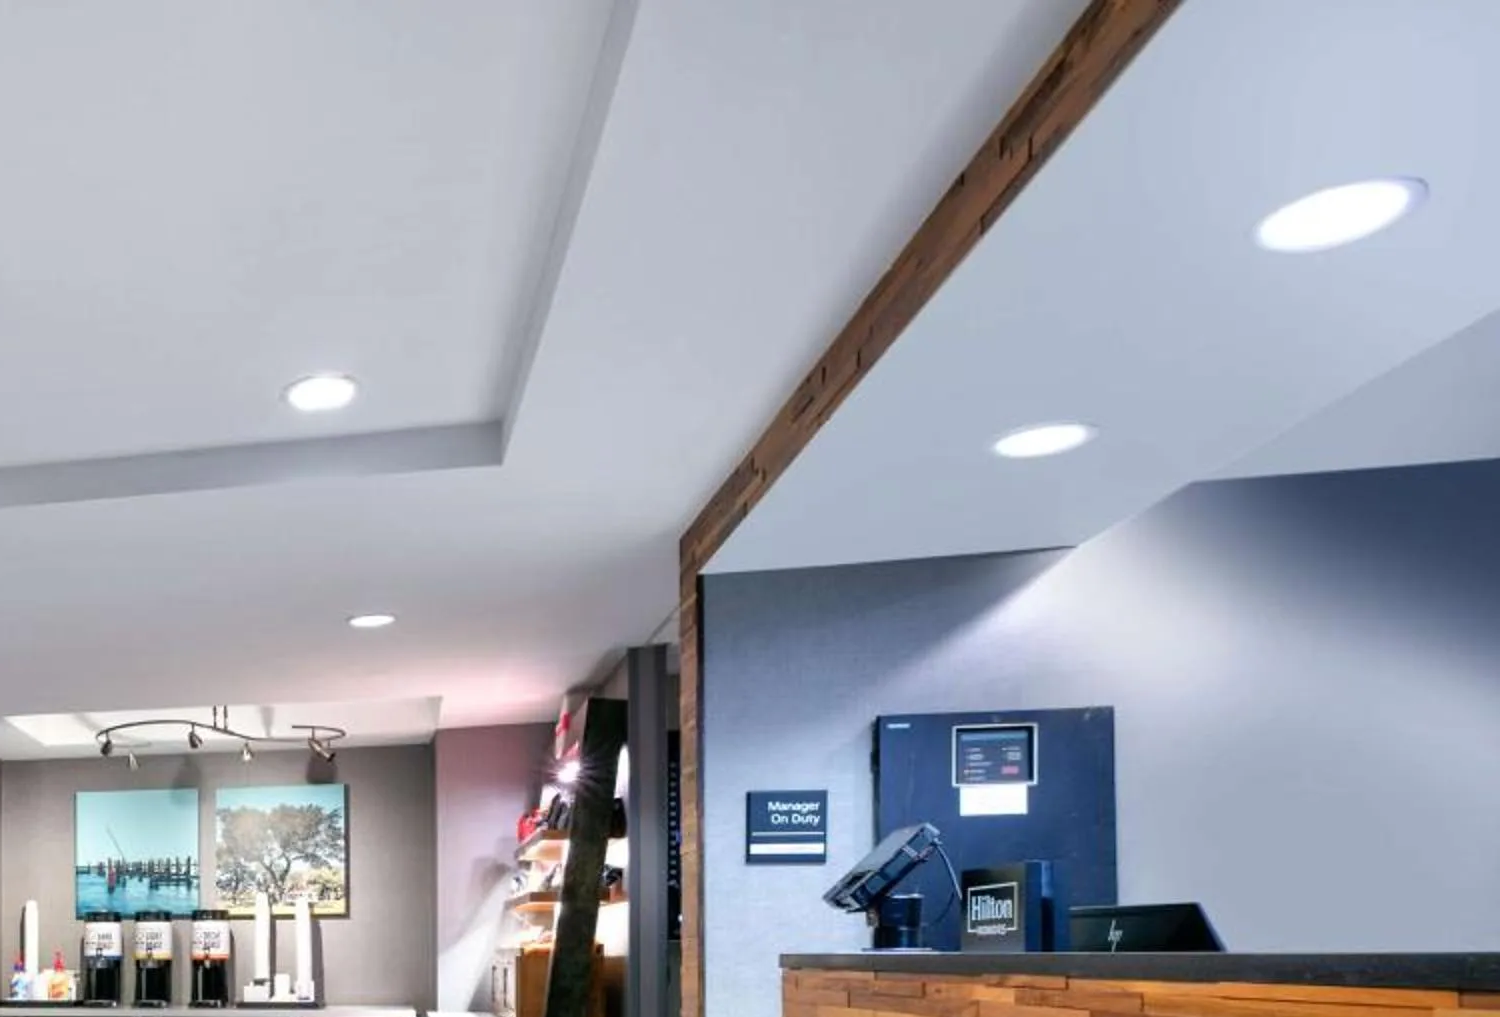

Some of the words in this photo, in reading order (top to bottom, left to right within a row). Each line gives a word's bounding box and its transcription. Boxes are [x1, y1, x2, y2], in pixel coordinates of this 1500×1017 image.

[767, 801, 820, 814] Manager
[771, 813, 789, 825] On
[791, 813, 821, 827] Duty
[971, 895, 1013, 921] Hilton
